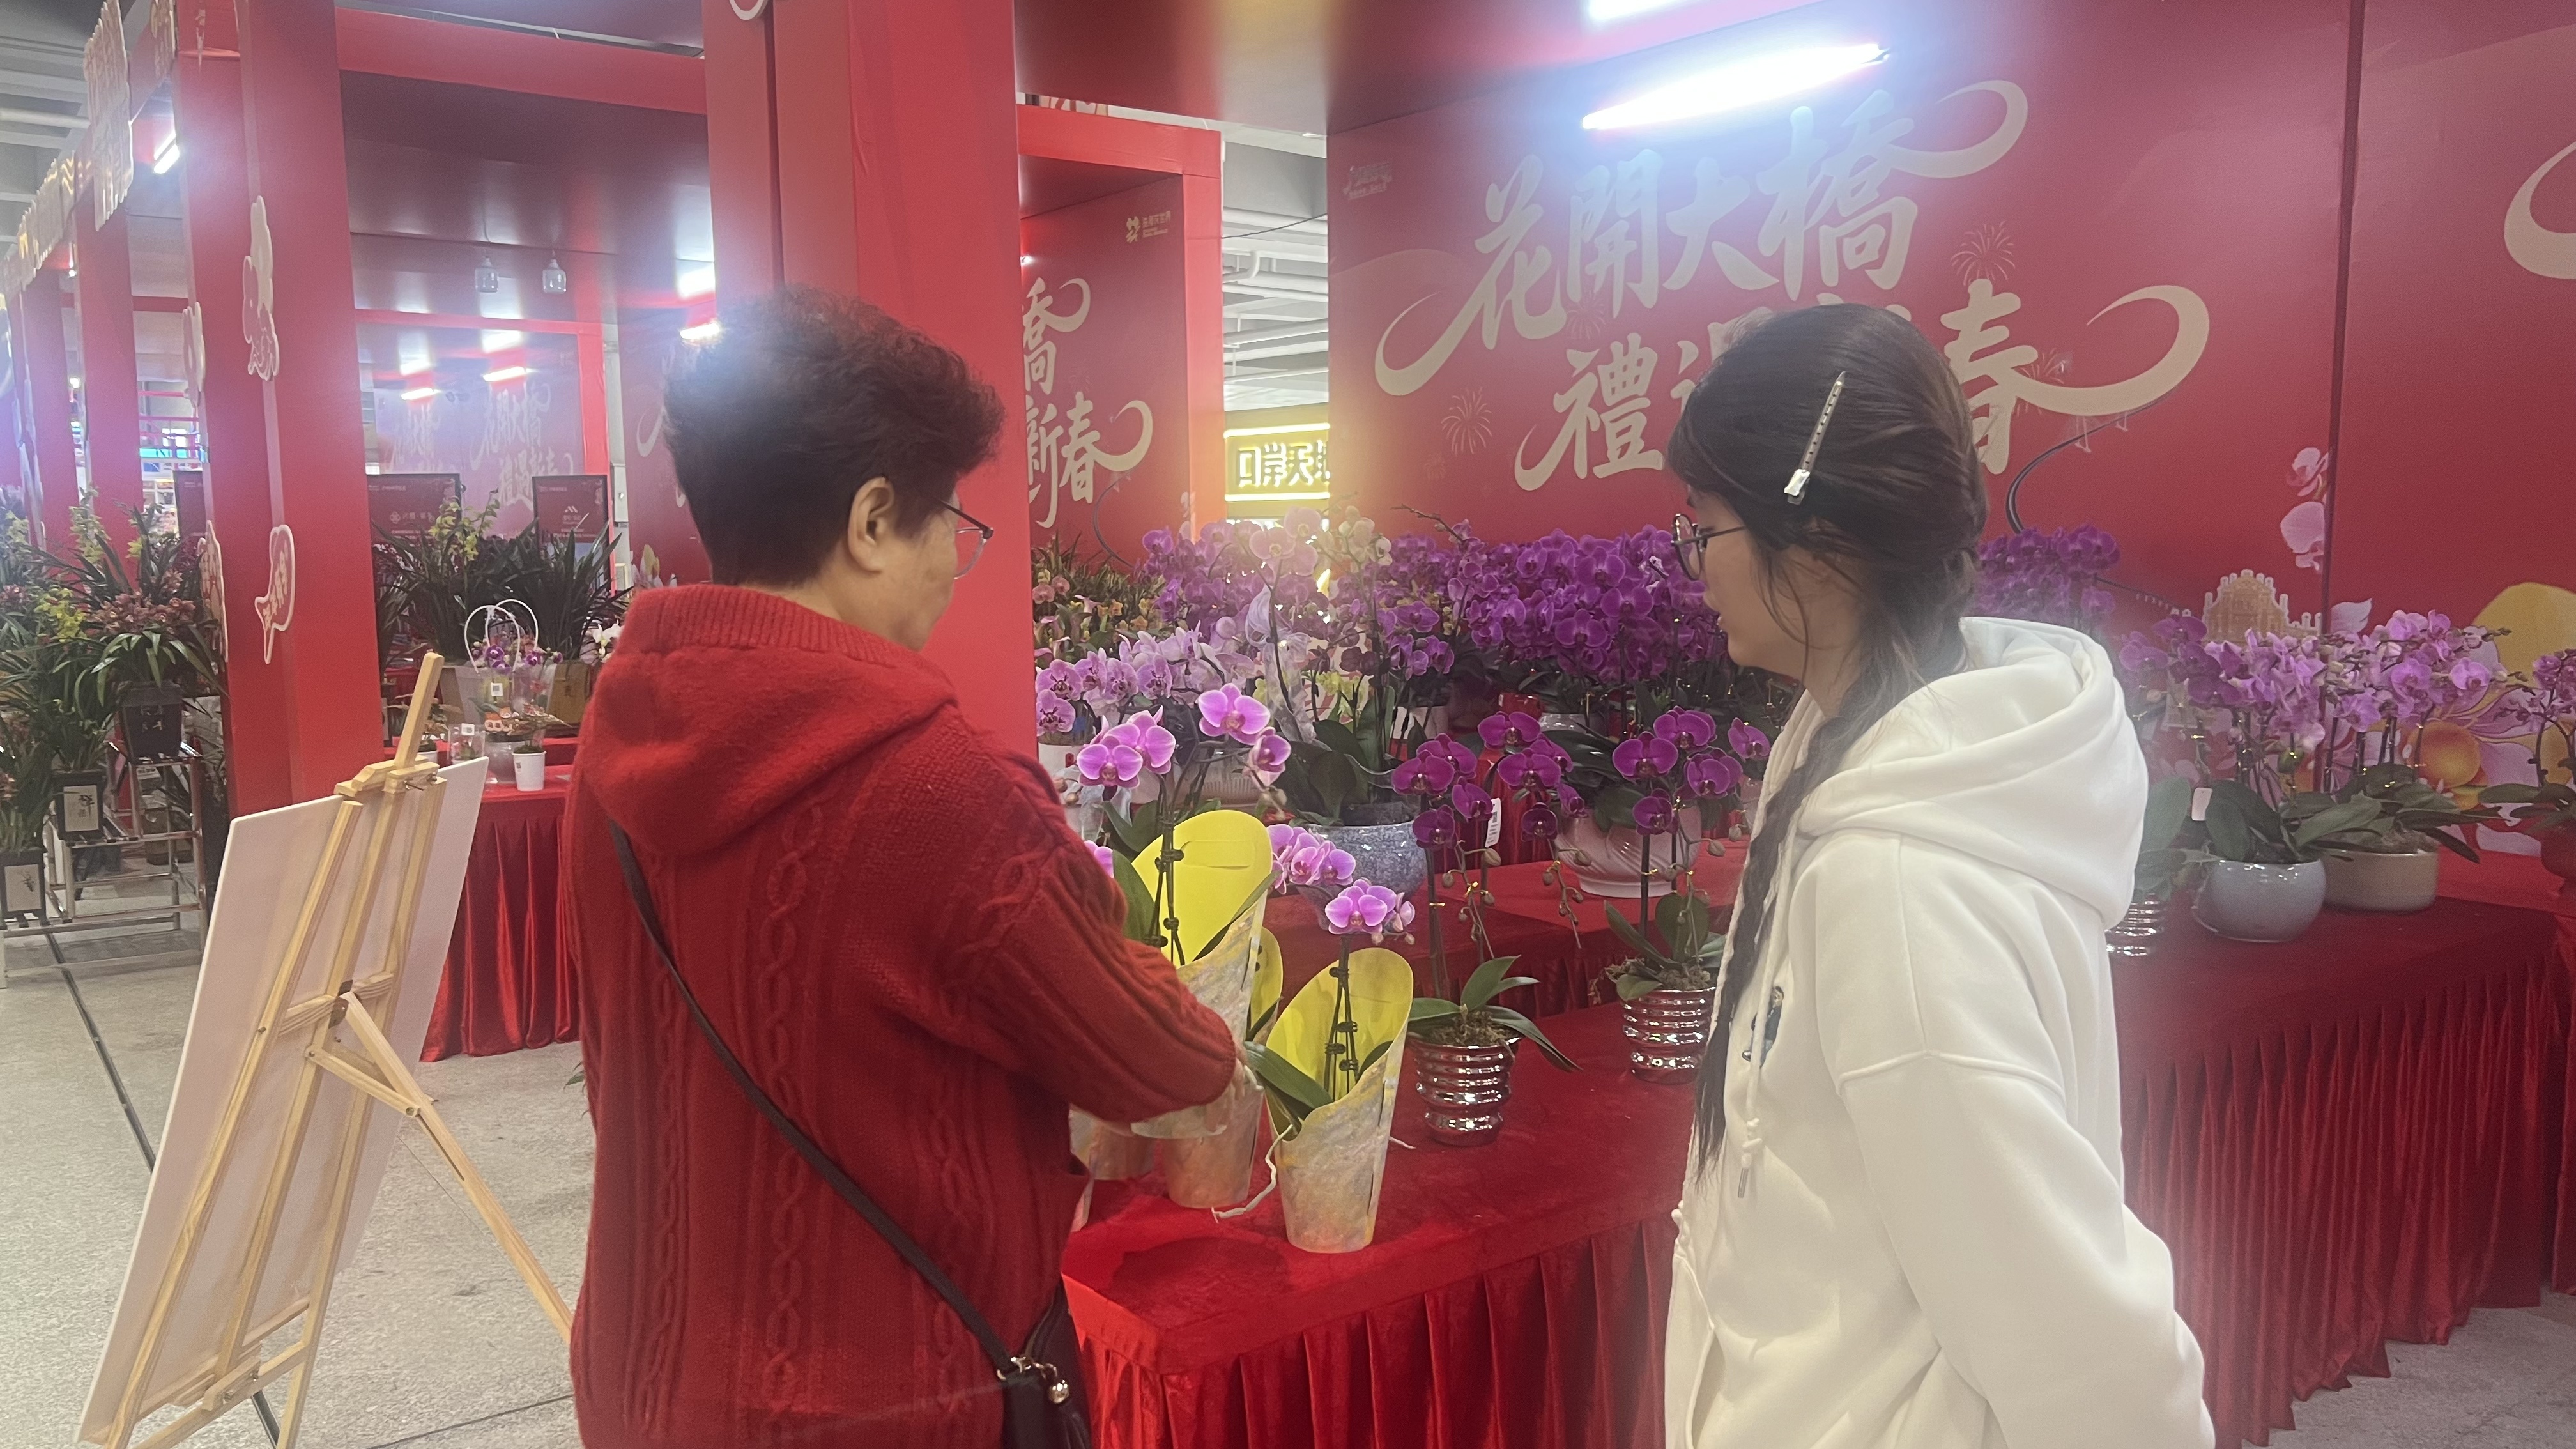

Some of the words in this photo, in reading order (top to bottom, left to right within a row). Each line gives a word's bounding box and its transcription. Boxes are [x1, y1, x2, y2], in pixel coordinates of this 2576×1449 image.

[1375, 79, 2028, 395] 花開大橋
[1515, 278, 2209, 491] 禮春
